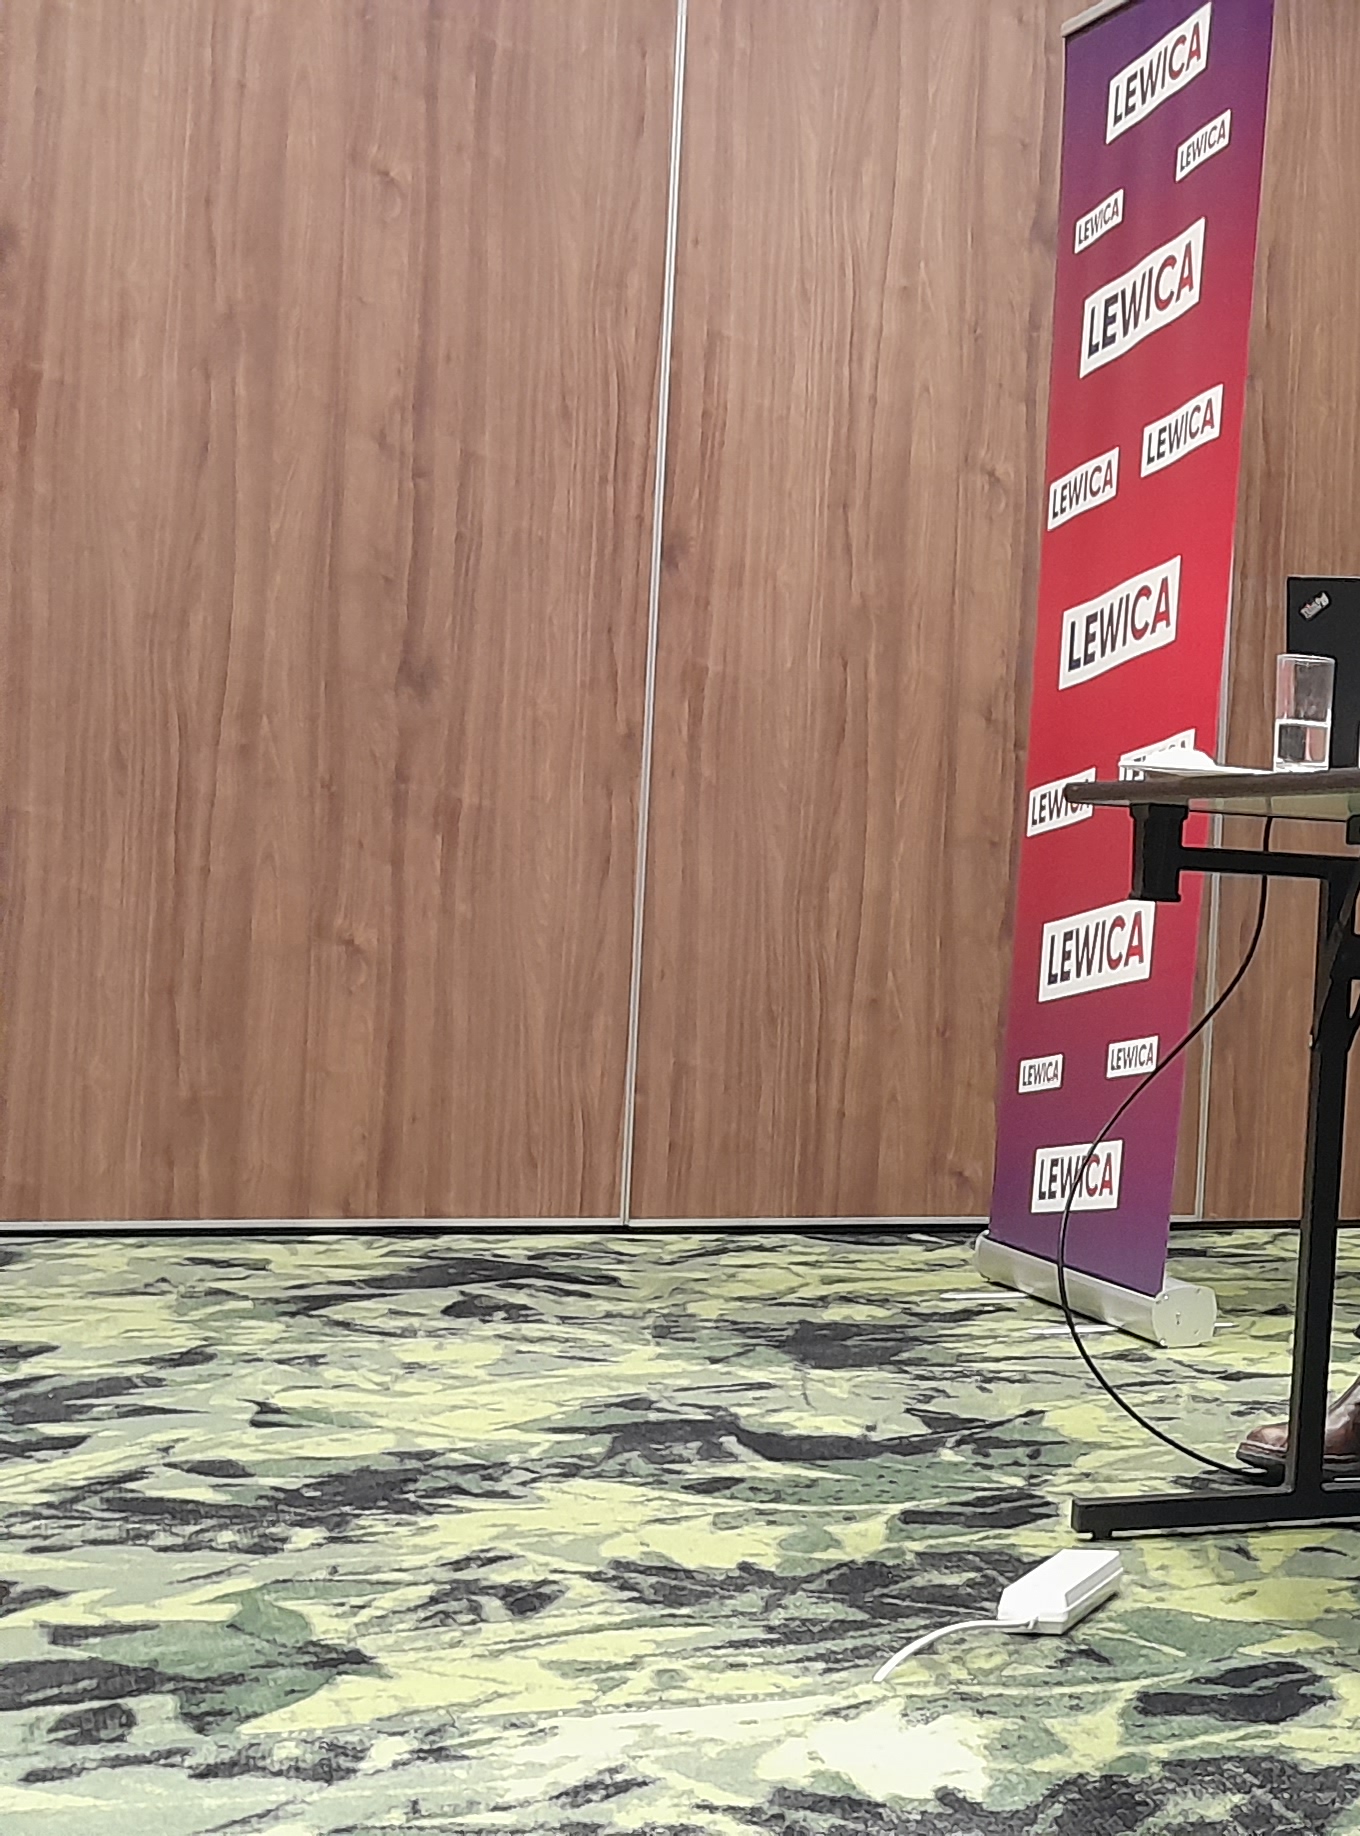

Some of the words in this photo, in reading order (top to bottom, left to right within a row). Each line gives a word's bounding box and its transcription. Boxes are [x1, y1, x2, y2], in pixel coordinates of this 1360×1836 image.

[1112, 21, 1202, 128] LEWICA
[1179, 119, 1226, 173] LEWICA
[1078, 197, 1120, 245] LEWICA
[1087, 240, 1194, 359] LEWICA
[1146, 398, 1215, 466] LEWICA
[1051, 459, 1114, 520] LEWICA
[1067, 576, 1171, 673] LEWICA
[1047, 910, 1144, 986] LEWICA
[1022, 1060, 1059, 1086] LEWICA
[1110, 1042, 1154, 1072] LEWICA
[1038, 1152, 1113, 1201] LEWICA
